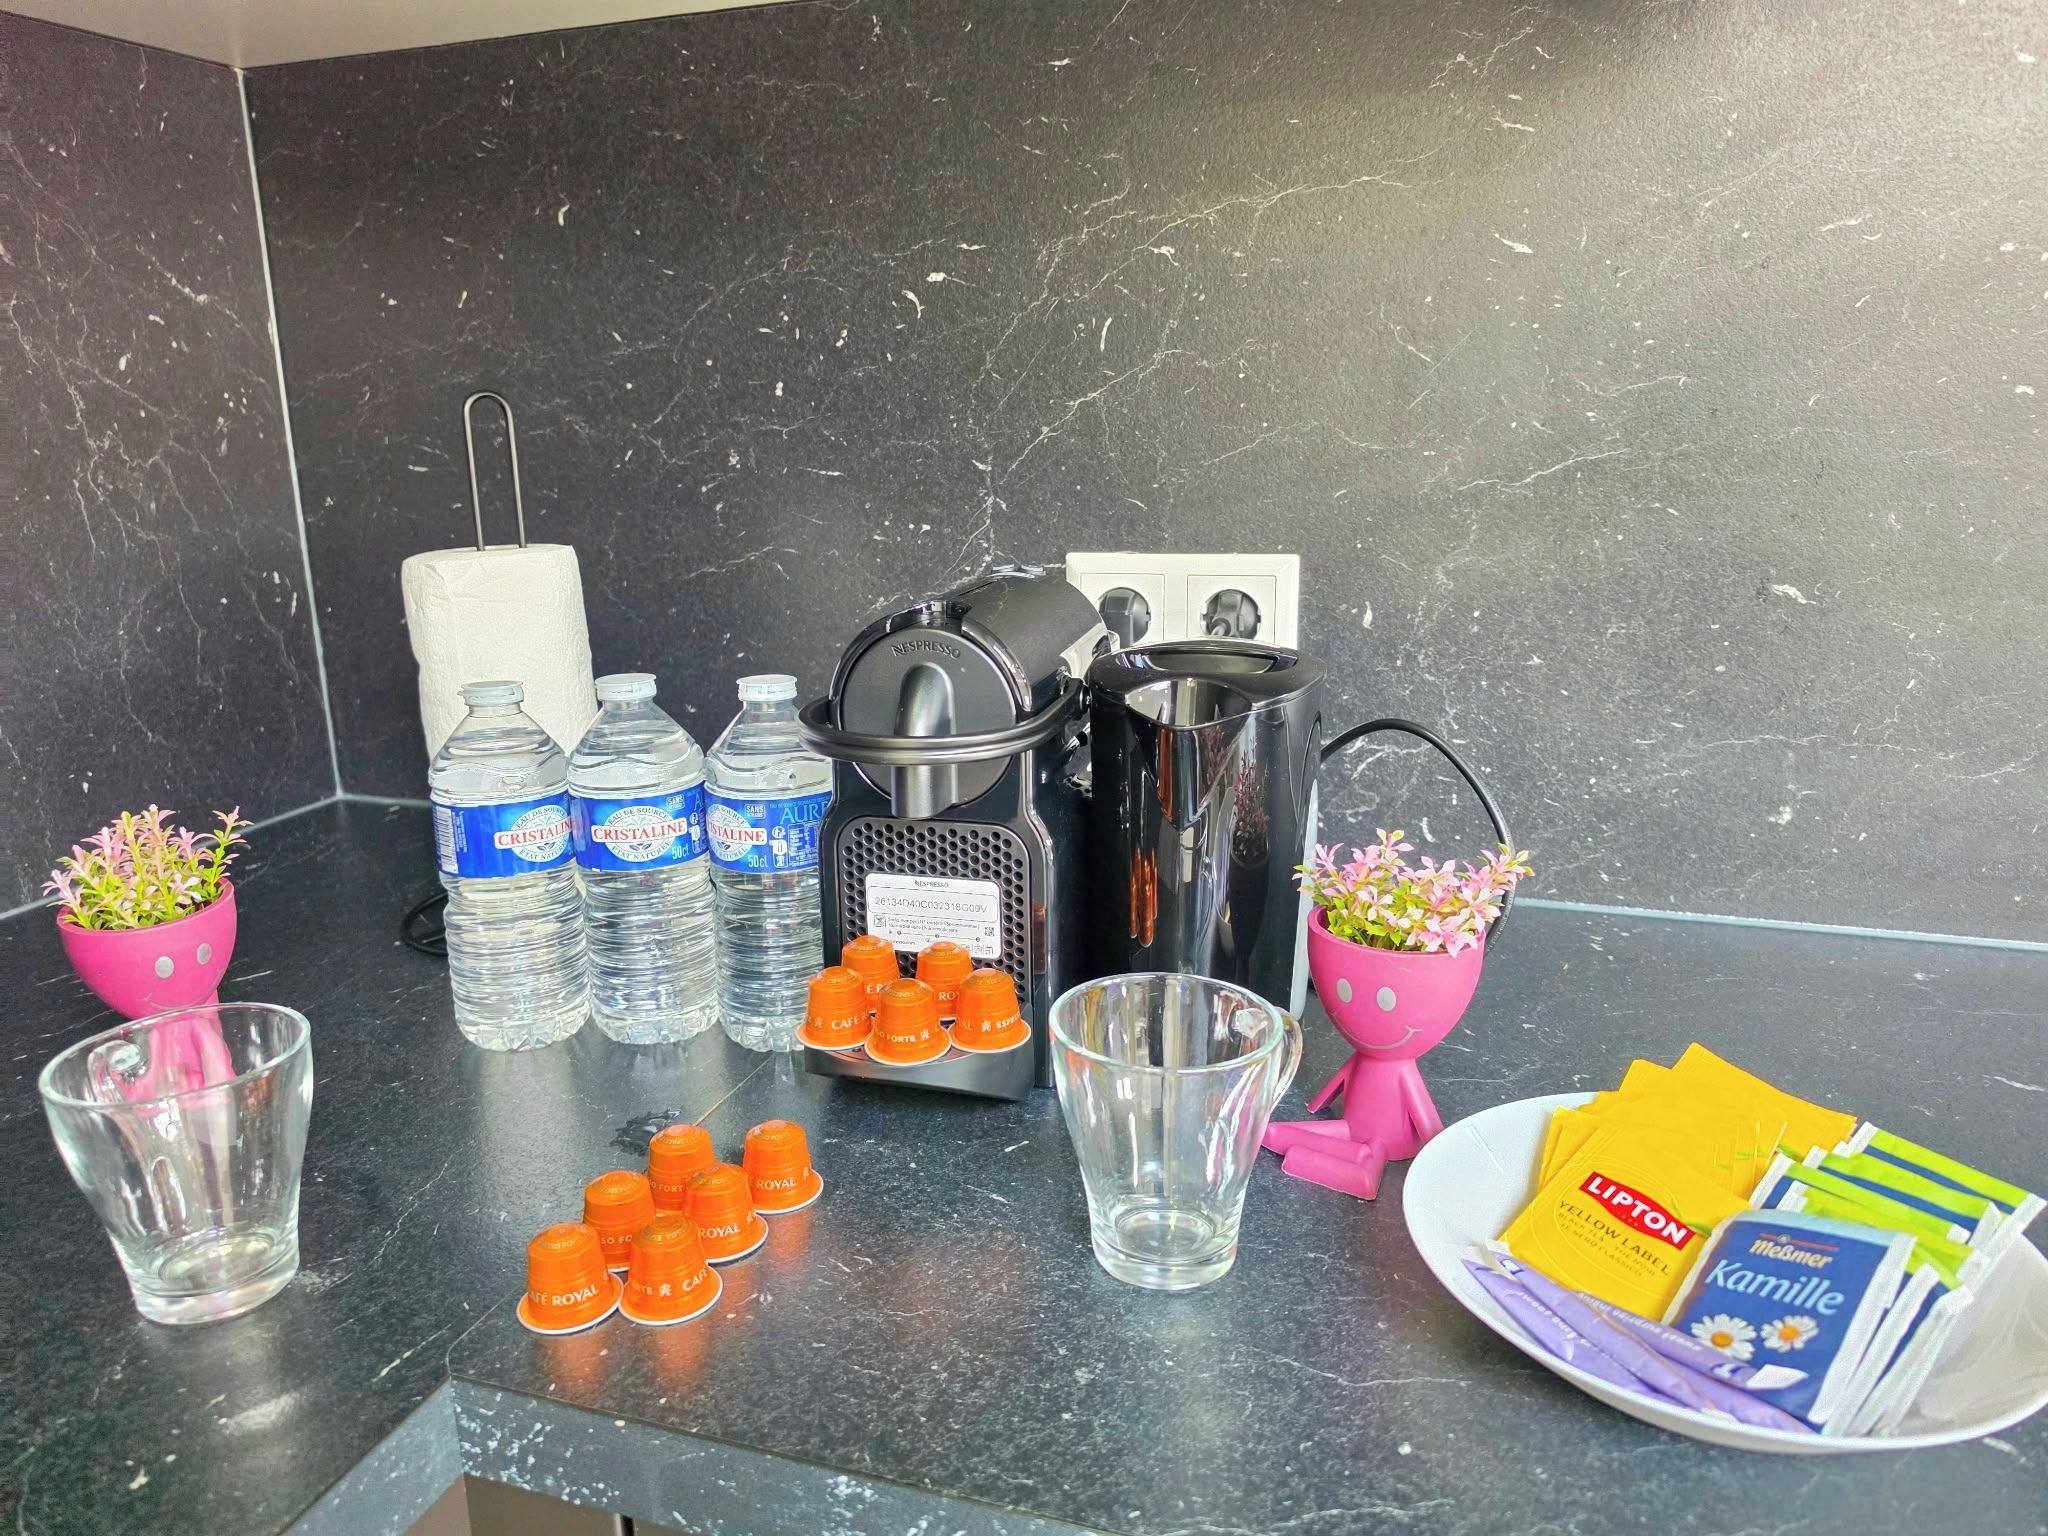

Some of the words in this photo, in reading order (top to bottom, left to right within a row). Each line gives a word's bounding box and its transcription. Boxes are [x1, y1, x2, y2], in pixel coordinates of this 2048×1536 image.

[891, 640, 960, 659] NESPRESSO
[607, 812, 622, 825] EAU
[624, 808, 635, 816] DE
[636, 807, 668, 821] SOURCE
[721, 807, 745, 827] SOURCE
[746, 805, 764, 813] SANS
[515, 815, 531, 829] EAU
[532, 809, 541, 818] DE
[498, 819, 572, 846] CRISTALIN
[593, 820, 686, 841] CRISTALINE
[708, 822, 765, 842] ISTALINE
[633, 842, 671, 860] NATUREL
[671, 843, 690, 860] 50cl
[748, 854, 768, 868] 50cl
[914, 880, 949, 888] NESPRESSO
[757, 1177, 798, 1191] ROYAL
[1587, 1176, 1688, 1244] LIPTON
[697, 1223, 741, 1239] ROYAL
[1560, 1200, 1620, 1239] YELLOW
[1622, 1238, 1670, 1276] LABEL
[531, 1291, 549, 1306] AFÉ
[552, 1284, 599, 1306] ROYAL
[1704, 1259, 1845, 1316] Kamille
